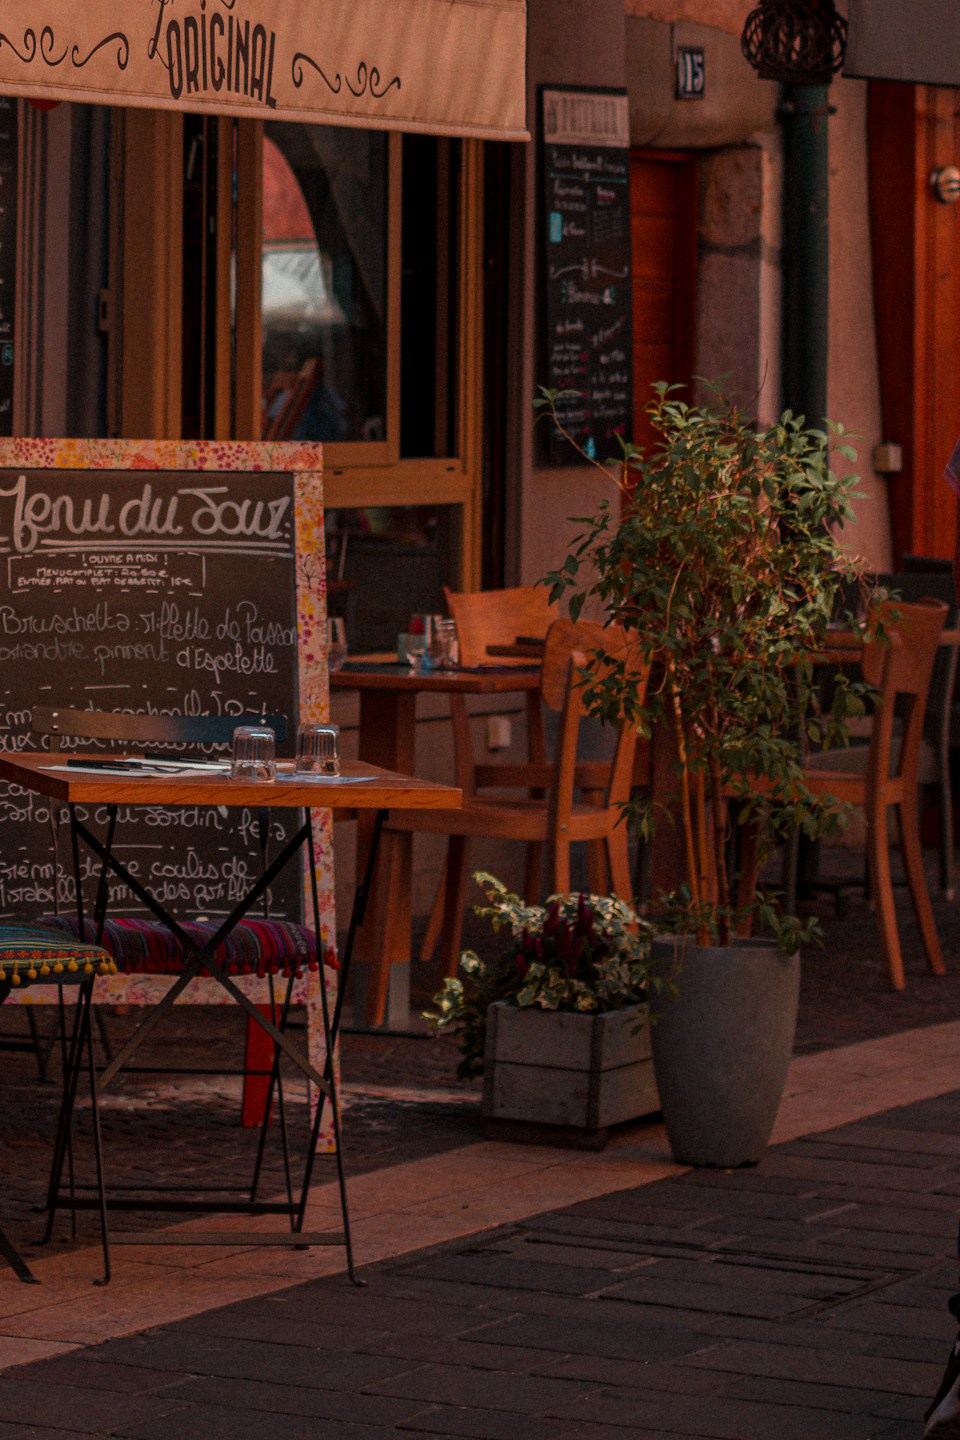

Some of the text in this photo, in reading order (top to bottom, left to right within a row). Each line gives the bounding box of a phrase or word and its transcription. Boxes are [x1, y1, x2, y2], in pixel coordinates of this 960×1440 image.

[684, 52, 704, 93] 15
[119, 484, 184, 535] du
[215, 607, 240, 641] de
[221, 855, 257, 880] de
